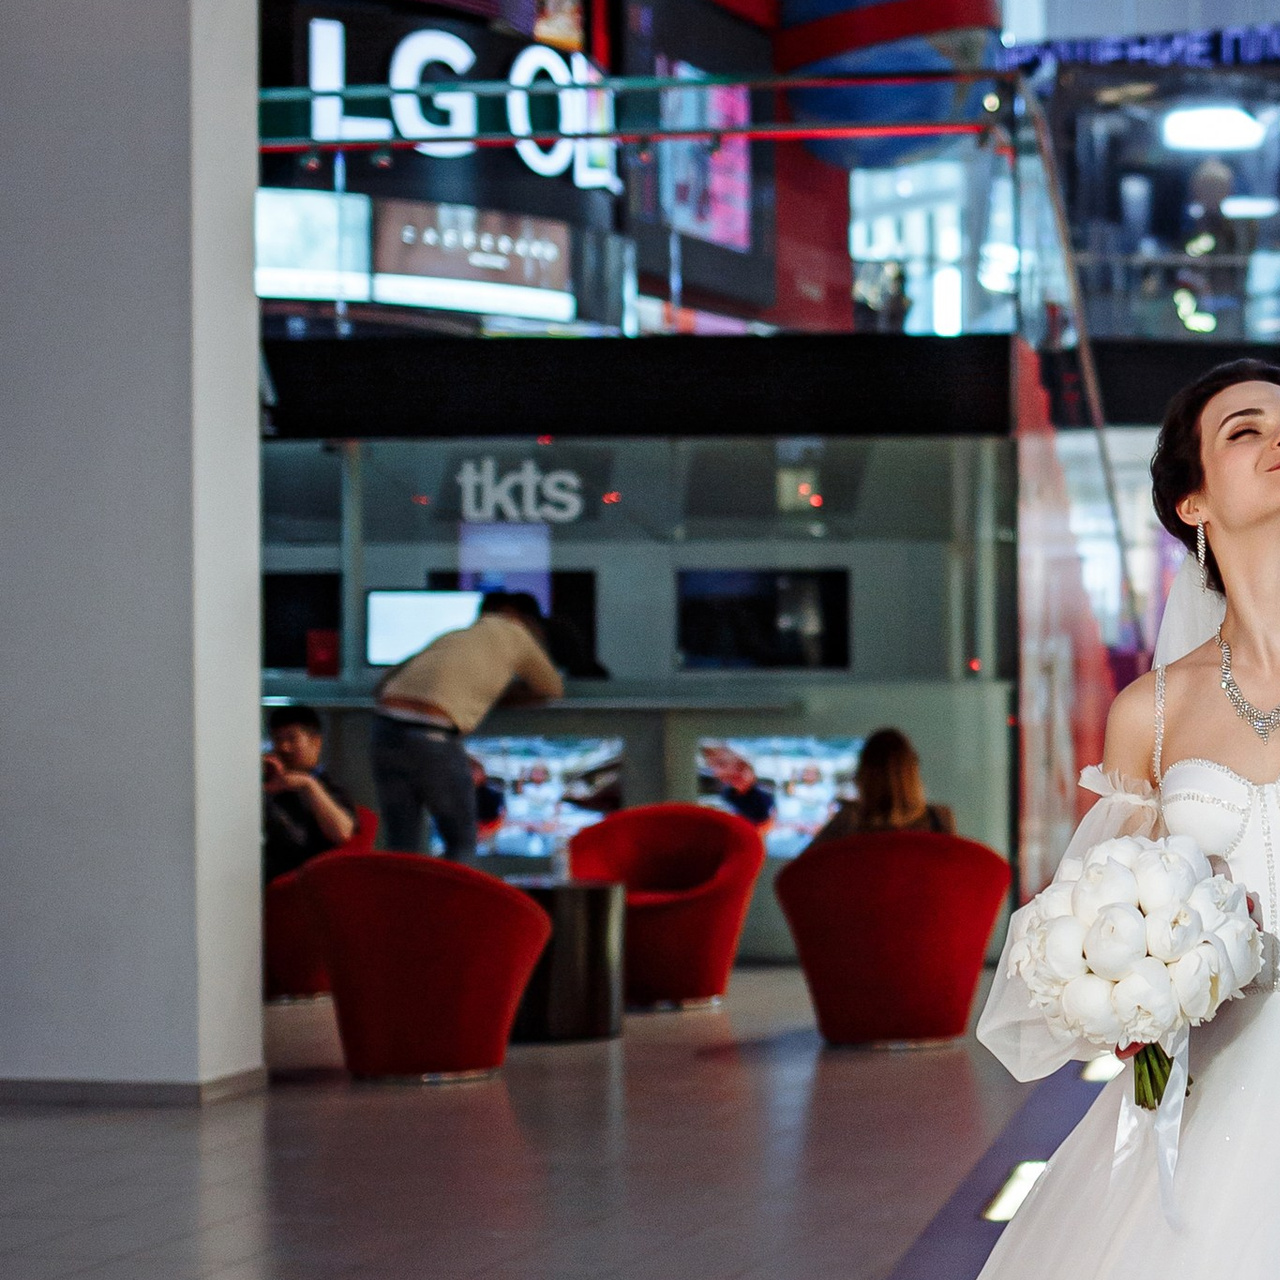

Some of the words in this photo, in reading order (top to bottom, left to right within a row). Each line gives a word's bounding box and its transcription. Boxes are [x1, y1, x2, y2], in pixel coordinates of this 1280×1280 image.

[308, 17, 478, 159] LG
[506, 44, 623, 195] OL
[455, 456, 583, 523] tkts
